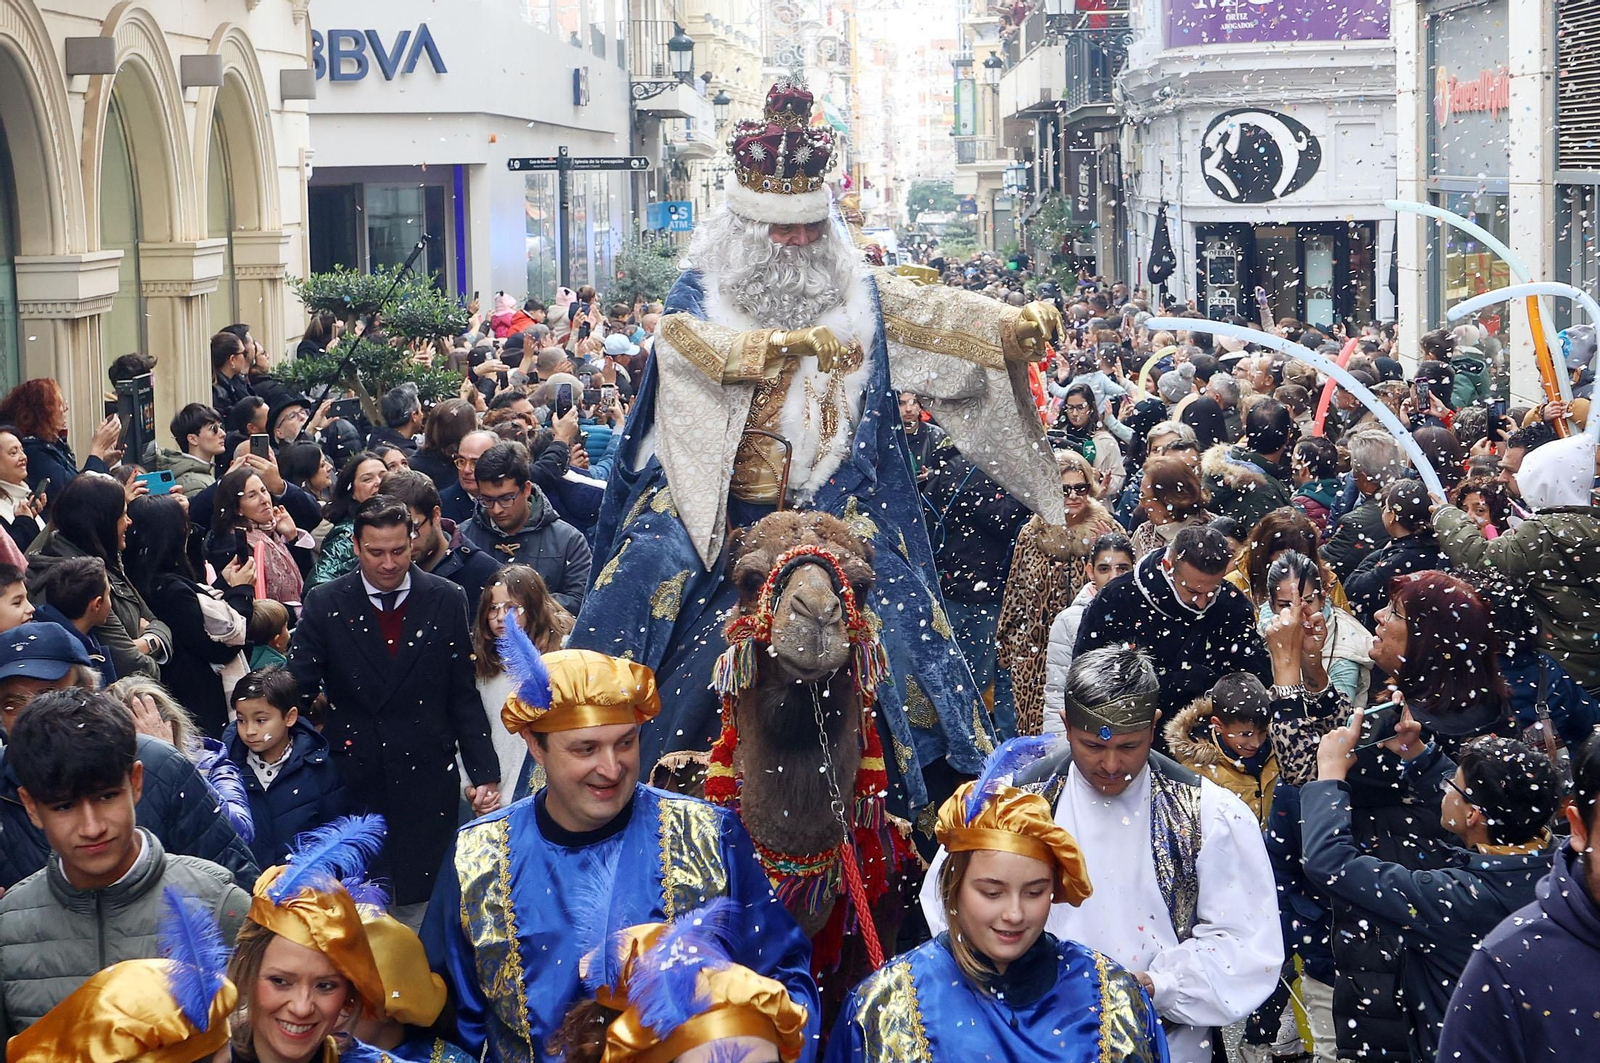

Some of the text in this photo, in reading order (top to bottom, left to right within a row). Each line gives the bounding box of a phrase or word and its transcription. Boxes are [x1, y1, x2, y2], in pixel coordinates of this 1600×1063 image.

[1225, 13, 1248, 21] ORTIZ
[1220, 22, 1255, 30] ABOGADOS
[1078, 163, 1090, 212] TIGER
[669, 220, 688, 229] ATM
